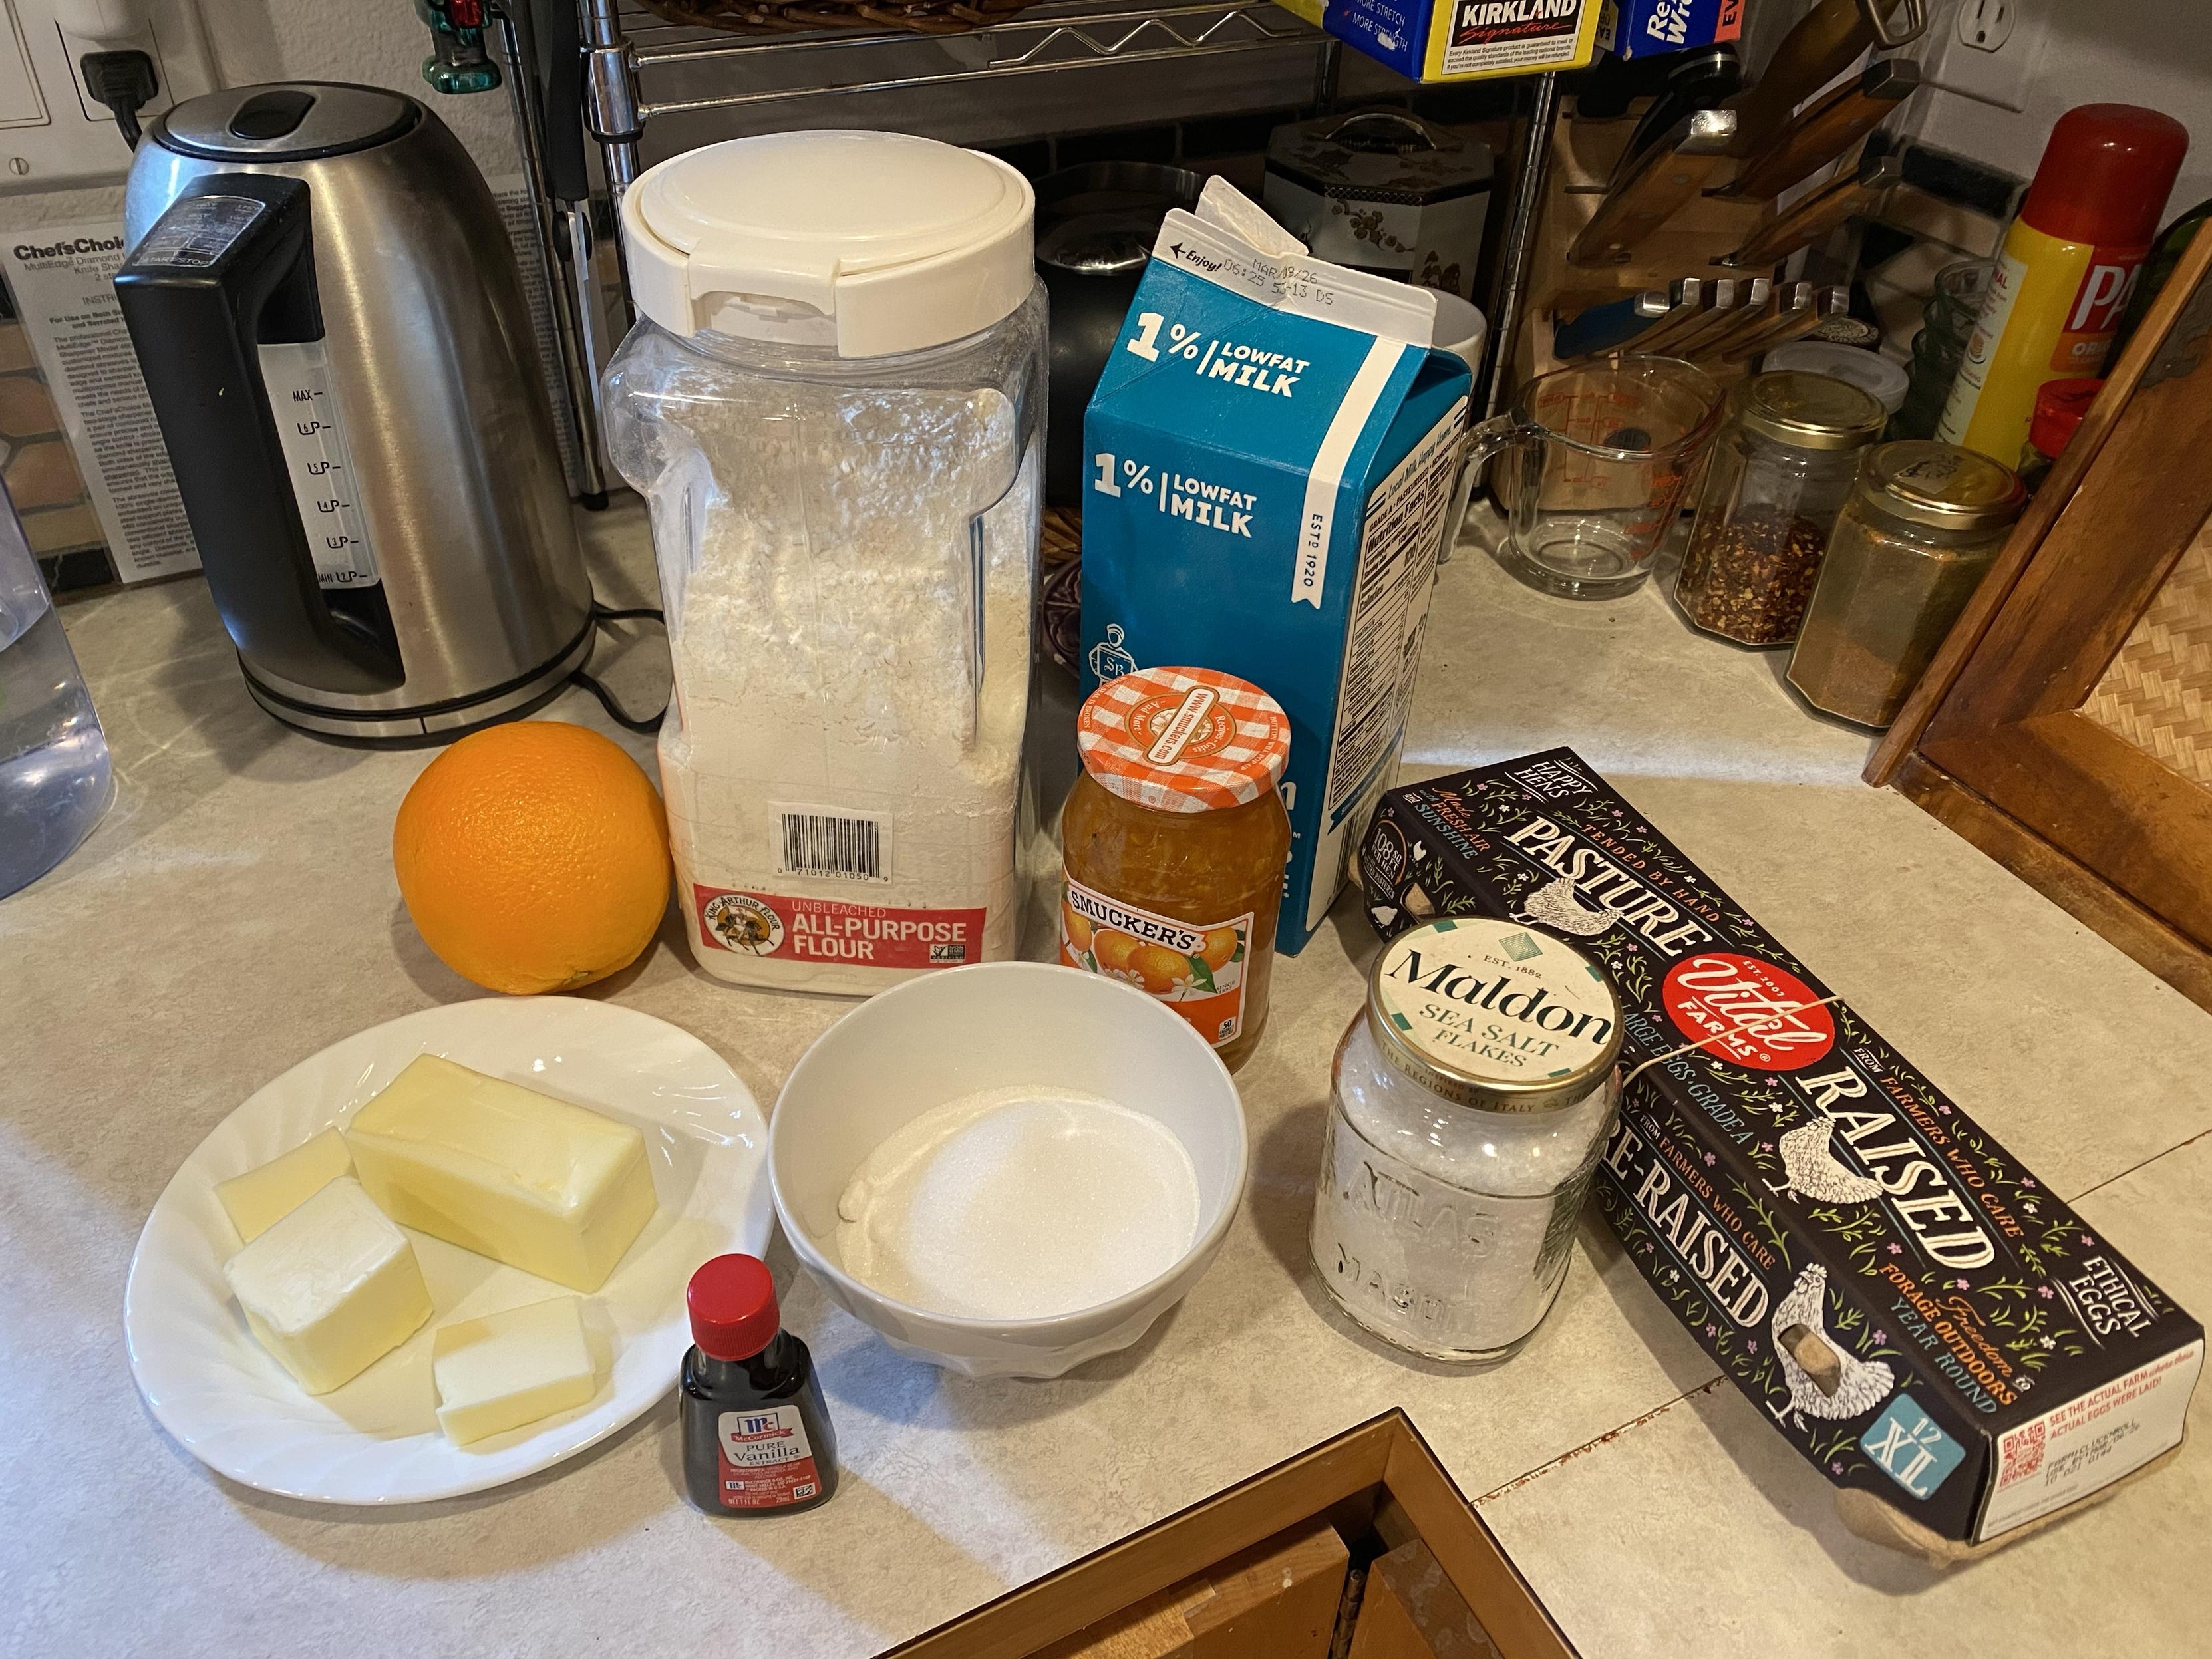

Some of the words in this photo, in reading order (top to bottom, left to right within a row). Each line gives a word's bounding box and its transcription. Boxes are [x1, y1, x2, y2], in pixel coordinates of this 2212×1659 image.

[1352, 12, 1373, 32] MORE
[1376, 3, 1406, 27] STRETCH
[1462, 0, 1577, 27] KIRKLAND
[1458, 21, 1573, 45] Signature
[1527, 40, 1551, 49] guaranteed
[1472, 59, 1495, 68] completely
[1488, 51, 1509, 60] standards
[74, 266, 99, 275] Knife
[76, 254, 121, 265] Diamond
[1185, 250, 1222, 273] Enjoy!
[1316, 289, 1334, 305] DS
[88, 318, 120, 327] Serrated
[1126, 312, 1201, 362] 1%
[1221, 342, 1310, 373] LOWFAT
[1208, 359, 1301, 398] MILK
[293, 389, 313, 402] MAX
[1094, 452, 1153, 498] 1%
[1388, 472, 1404, 499] Local
[1418, 442, 1436, 466] Happy
[1174, 474, 1257, 510] LOWFAT
[1368, 508, 1389, 533] GRADE
[1396, 466, 1429, 508] PASTEURIZED
[1170, 494, 1253, 538] MILK
[1367, 513, 1404, 555] Nutrition
[1404, 489, 1425, 518] Facts
[318, 573, 333, 583] MIN
[1303, 554, 1317, 587] 1920
[1359, 584, 1384, 614] Calories
[1083, 705, 1092, 728] BROKEN
[1132, 712, 1146, 731] More
[1140, 700, 1160, 716] And
[1154, 693, 1208, 760] www.smuckers.com
[1214, 715, 1226, 742] Recipes
[1269, 716, 1279, 742] BUTTON
[1192, 743, 1217, 754] Gifts
[1251, 755, 1263, 767] POP
[1240, 763, 1252, 772] UP
[1514, 768, 1569, 798] HENS
[1531, 760, 1593, 796] HAPPY
[1402, 792, 1422, 804] and
[1432, 787, 1477, 820] Made
[1414, 801, 1478, 860] SUNSHINE
[1431, 800, 1473, 839] FRESH
[1466, 832, 1492, 853] AIR
[1374, 828, 1394, 860] 108
[1392, 850, 1402, 865] SQ
[835, 871, 869, 881] 01050
[1371, 843, 1382, 863] PER
[1380, 859, 1396, 880] HEN
[1389, 858, 1400, 871] FT
[1580, 824, 1647, 871] TENDED
[1649, 871, 1674, 887] BY
[1672, 888, 1720, 923] HAND
[1373, 872, 1396, 900] PASTURES
[1503, 816, 1713, 956] PASTURE
[705, 902, 720, 921] KING
[720, 897, 760, 910] ARTHUR
[759, 906, 780, 931] FLOUR
[792, 901, 887, 919] UNBLEACHED
[1070, 890, 1196, 951] SMUCKER'S
[792, 914, 967, 943] ALL-PURPOSE
[794, 935, 875, 960] FLOUR
[1482, 954, 1511, 969] EST.
[1516, 965, 1543, 980] 1882
[1742, 960, 1760, 977] EST.
[1760, 977, 1786, 997] 2001
[1384, 948, 1612, 1045] Maldon
[1677, 958, 1828, 1051] Vital
[1223, 1019, 1232, 1029] 50
[1419, 1003, 1474, 1034] SEA
[1480, 1023, 1559, 1058] SALT
[1676, 1001, 1758, 1057] FARMS
[1434, 1028, 1528, 1068] FLAKES
[1379, 1040, 1400, 1066] THE
[1404, 1064, 1462, 1102] REGIONS
[1468, 1096, 1487, 1109] OF
[1492, 1100, 1535, 1114] ITALY
[1564, 1090, 1589, 1106] THE
[1688, 1084, 1745, 1132] GRADE
[1730, 1131, 1754, 1145] A
[1853, 1047, 1883, 1074] FROM
[1880, 1076, 1951, 1146] FARMERS
[1947, 1148, 1985, 1189] WHO
[1980, 1193, 2025, 1238] CARE
[1795, 1066, 1995, 1270] RAISED
[1639, 1114, 1661, 1139] FROM
[1659, 1136, 1714, 1199] FARMERS
[1711, 1195, 1742, 1232] WHO
[1742, 1231, 1776, 1271] CARE
[2069, 1273, 2121, 1336] EGGS
[2082, 1255, 2152, 1338] ETHICAL
[1879, 1262, 1941, 1323] FORAGE
[1934, 1320, 2018, 1406] OUTDOORS
[1935, 1295, 2014, 1378] Freedom
[1889, 1296, 1939, 1351] YEAR
[1933, 1352, 1998, 1415] ROUND
[2049, 1411, 2067, 1428] SEE
[2068, 1402, 2086, 1419] THE
[2088, 1384, 2122, 1410] ACTUAL
[2123, 1369, 2149, 1389] FARM
[2050, 1417, 2086, 1441] ACTUAL
[2087, 1404, 2112, 1421] EGGS
[2112, 1389, 2138, 1409] WERE
[2138, 1376, 2163, 1395] LAID!
[734, 1430, 787, 1442] McCormick
[746, 1441, 785, 1452] PURE
[1909, 1417, 1943, 1445] 12
[734, 1446, 800, 1462] Vanilla
[1864, 1416, 1938, 1497] XL
